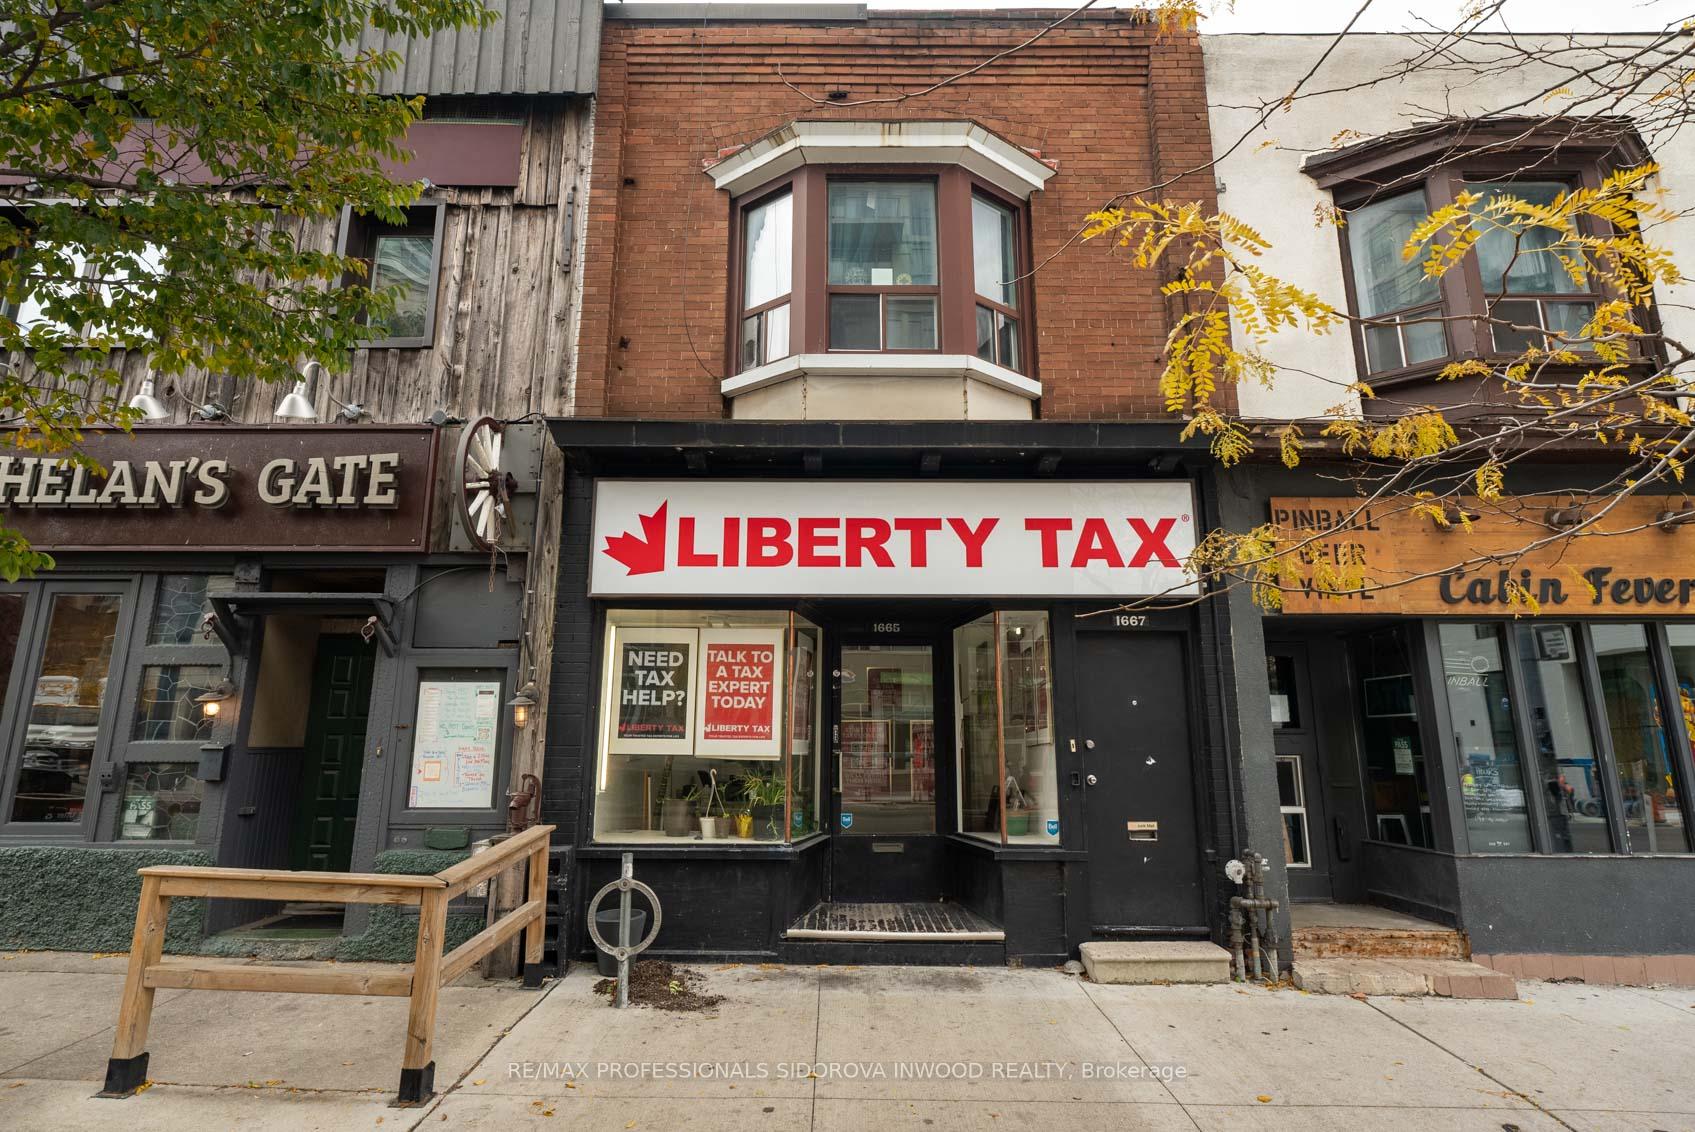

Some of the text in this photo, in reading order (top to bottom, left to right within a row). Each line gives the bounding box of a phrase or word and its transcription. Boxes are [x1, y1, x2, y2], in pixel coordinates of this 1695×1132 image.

[257, 452, 400, 505] GATE
[1275, 509, 1380, 531] PINBALL
[677, 517, 1000, 568] LIBERTY
[1439, 567, 1568, 605] Cabin
[1116, 615, 1146, 626] 1667
[873, 623, 900, 633] 1665
[628, 651, 684, 667] NEED
[708, 650, 773, 663] TALK TO
[634, 670, 675, 686] TAX
[716, 666, 763, 678] A TAX
[708, 681, 770, 694] EXPERT
[622, 689, 686, 707] HELP?
[711, 695, 765, 709] TODAY
[627, 723, 685, 732] LIBERTY TAX
[711, 724, 770, 733] LIBERTY TAX
